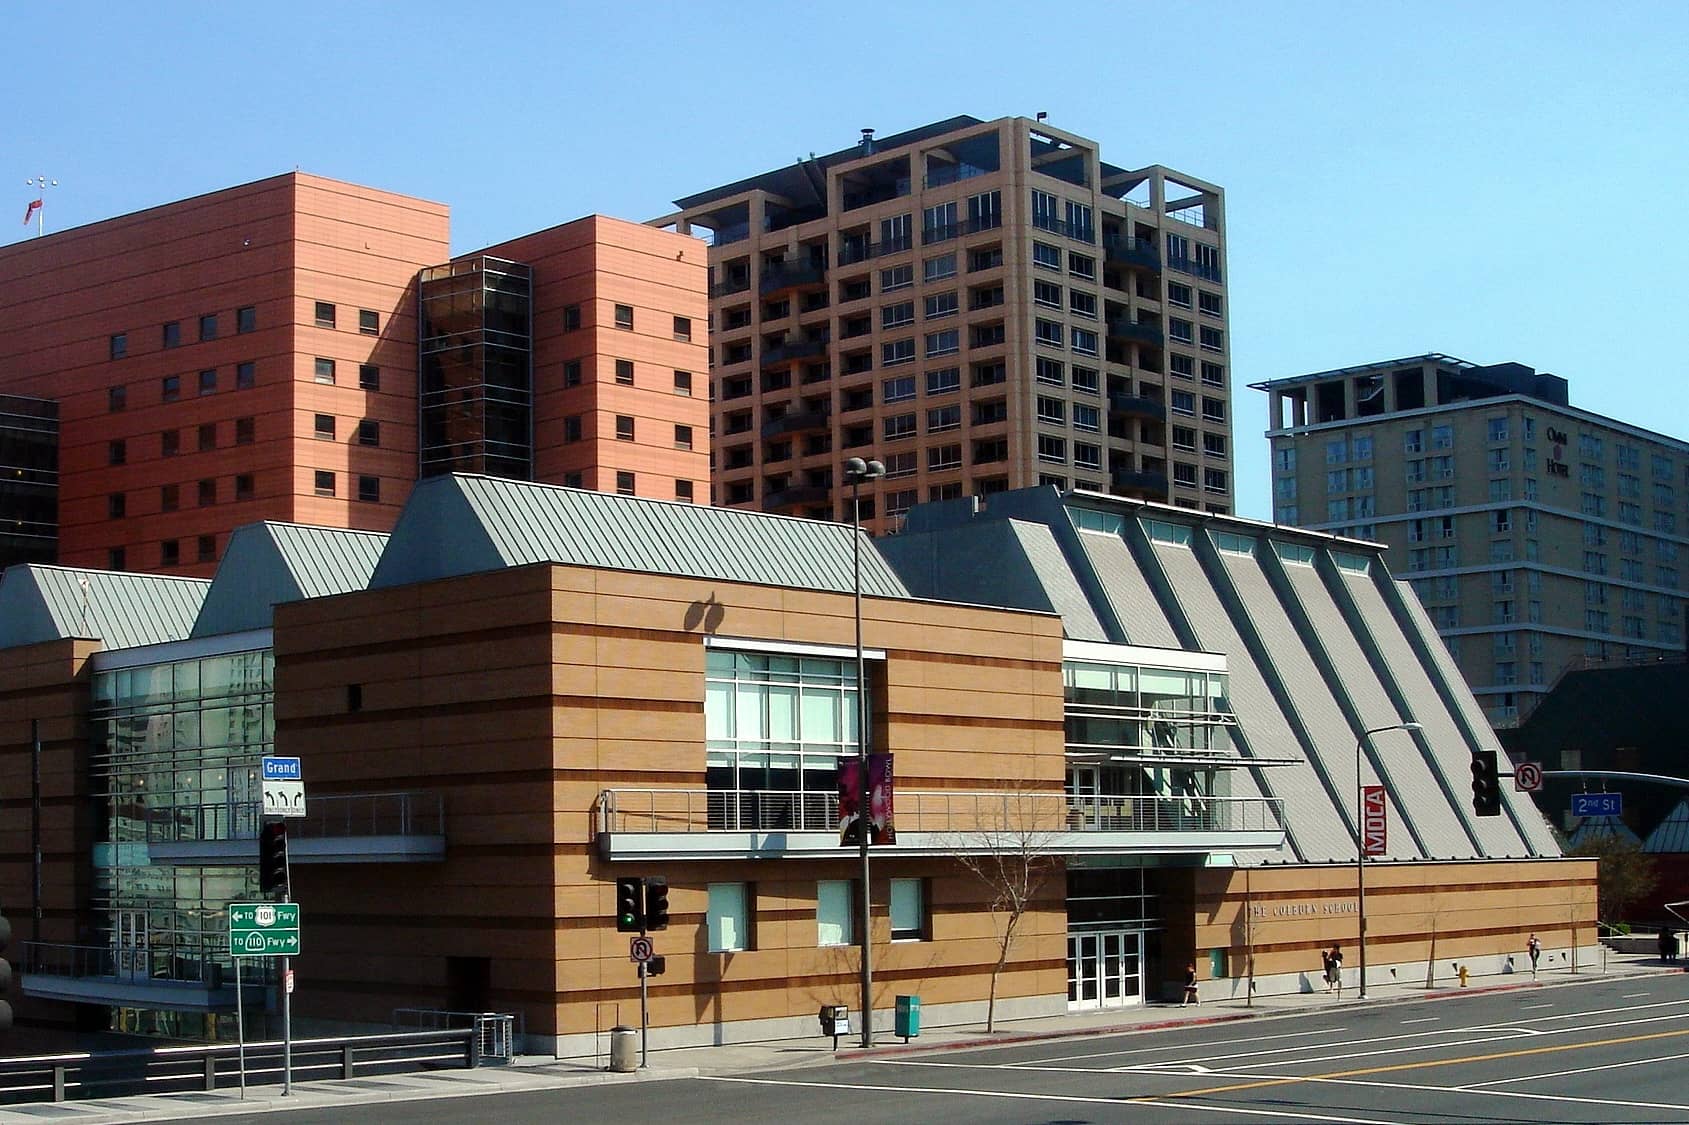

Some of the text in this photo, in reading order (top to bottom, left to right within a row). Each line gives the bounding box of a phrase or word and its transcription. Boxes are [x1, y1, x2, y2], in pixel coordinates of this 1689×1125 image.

[267, 761, 296, 774] Grand
[1603, 799, 1616, 810] St
[1366, 790, 1385, 852] MOCA
[1323, 901, 1359, 914] SCHOOL
[260, 911, 272, 920] 101
[277, 911, 296, 922] Fwy
[249, 937, 262, 947] 110
[267, 937, 286, 948] Fwy
